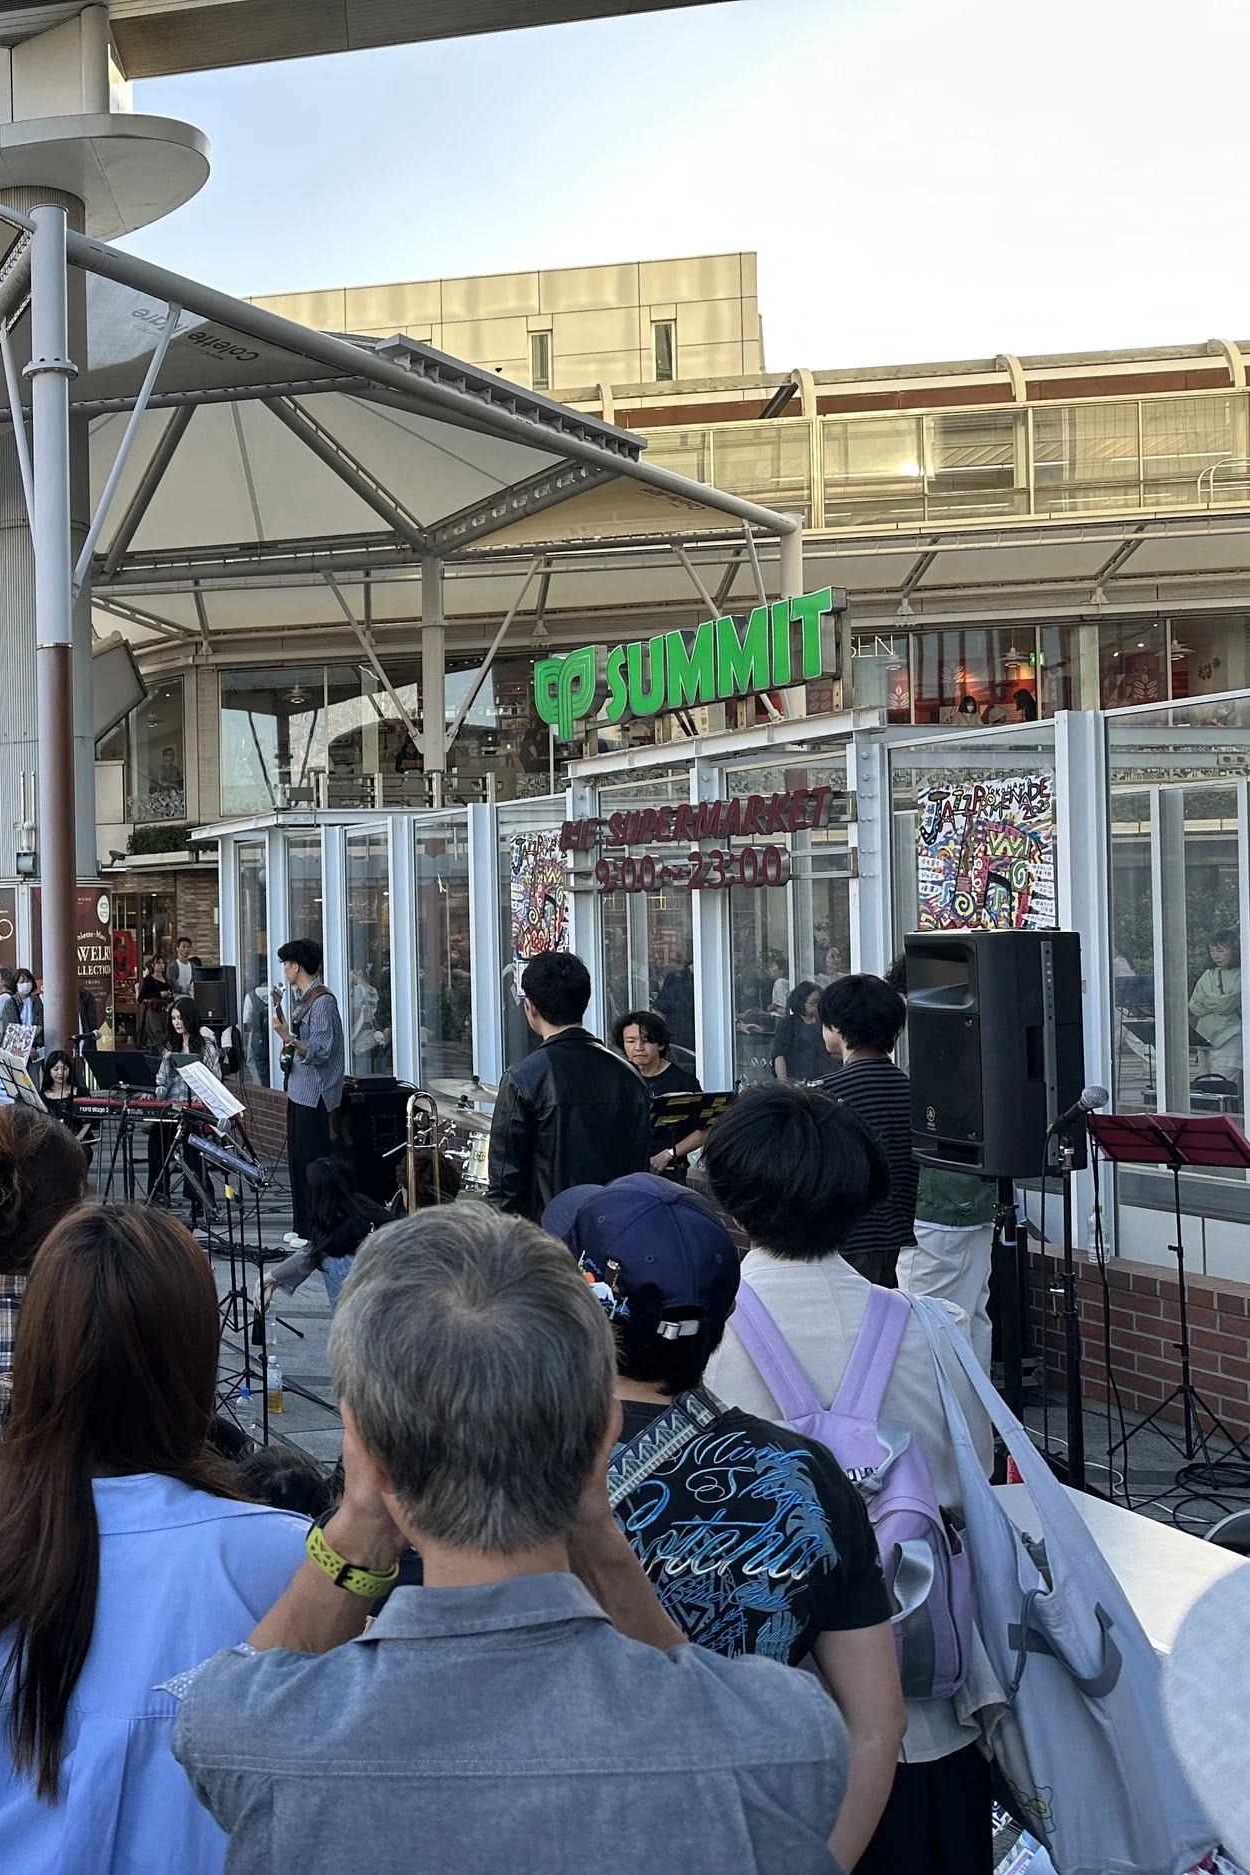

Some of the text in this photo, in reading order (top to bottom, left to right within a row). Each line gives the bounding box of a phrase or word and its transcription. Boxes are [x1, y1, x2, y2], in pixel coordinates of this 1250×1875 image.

[188, 331, 260, 361] Colette
[606, 586, 834, 724] SUMMIT
[607, 785, 833, 847] SUPERMARKET
